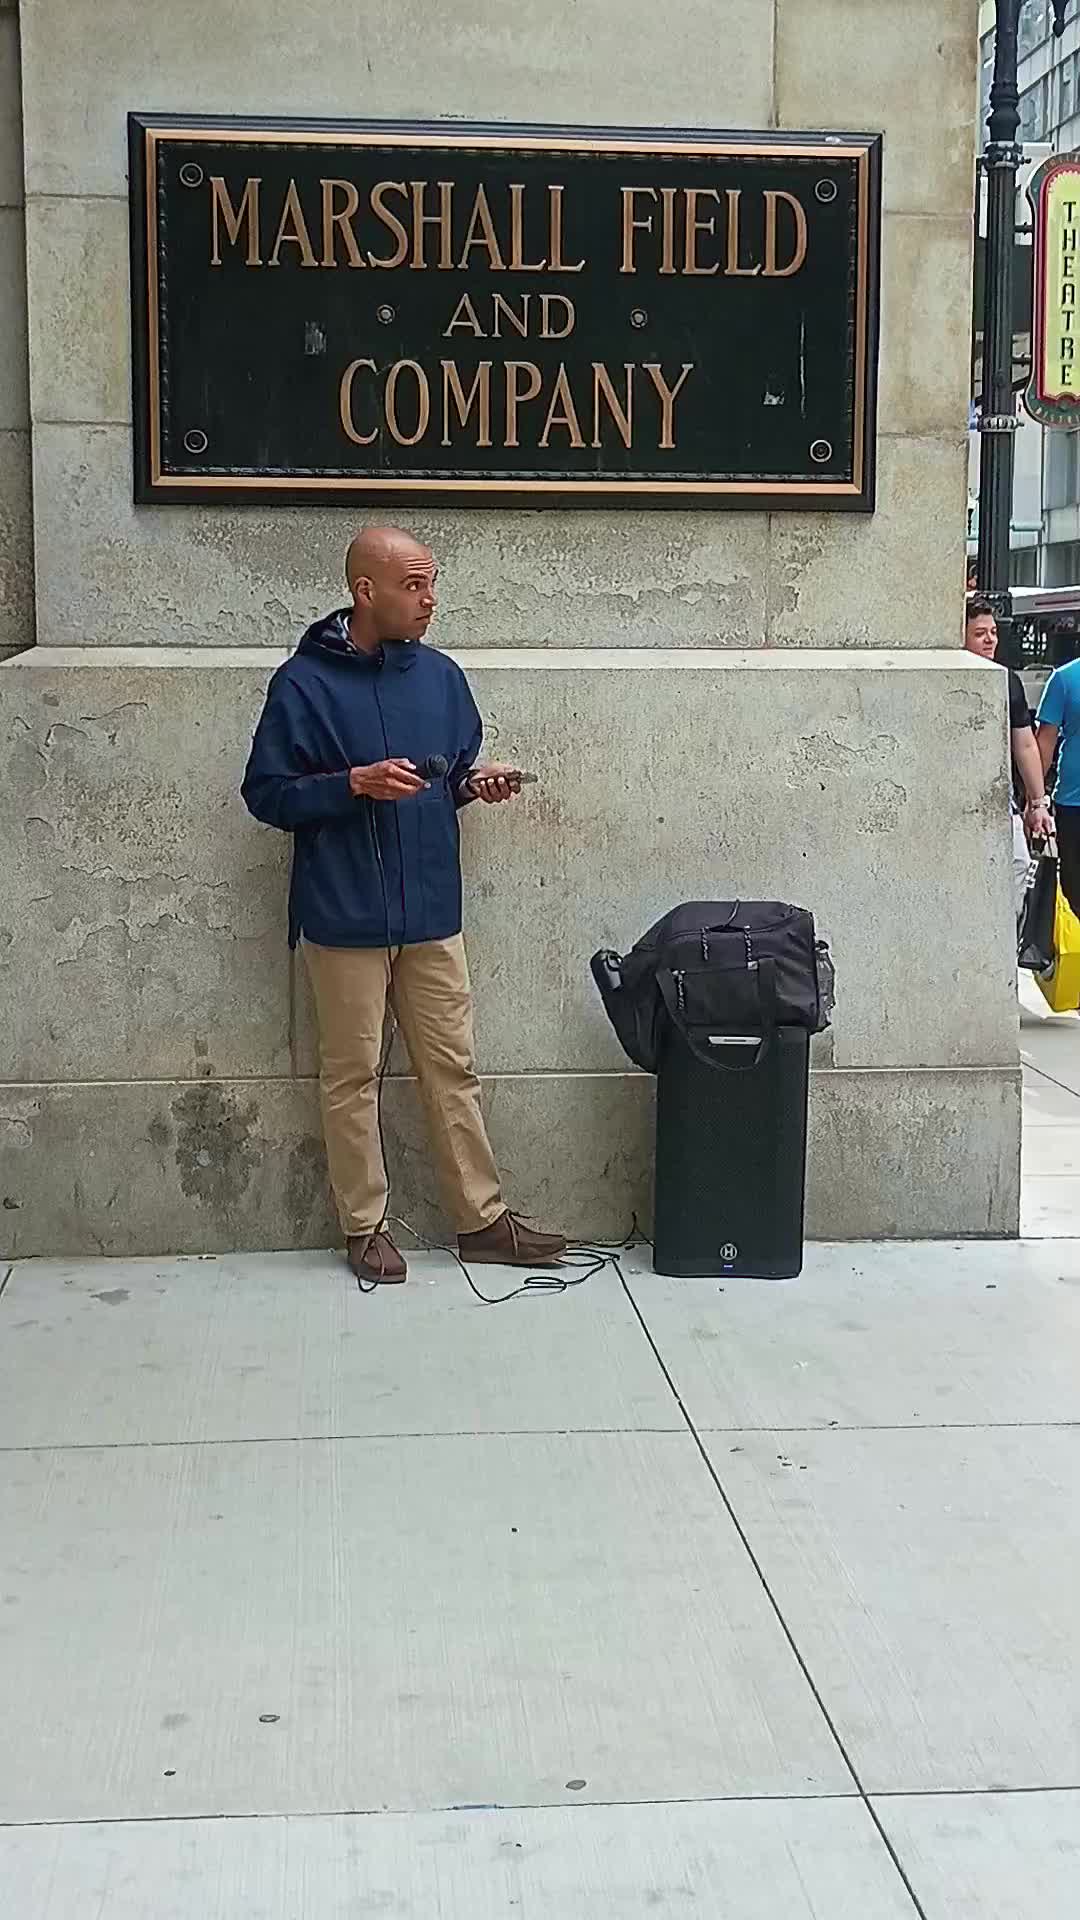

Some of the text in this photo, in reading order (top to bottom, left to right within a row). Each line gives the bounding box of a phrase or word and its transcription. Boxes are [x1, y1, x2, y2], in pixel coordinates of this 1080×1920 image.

[209, 177, 808, 277] MARSHALL FIELD
[442, 293, 576, 339] AND
[1060, 201, 1077, 387] THEATRE
[338, 358, 695, 450] COMPANY
